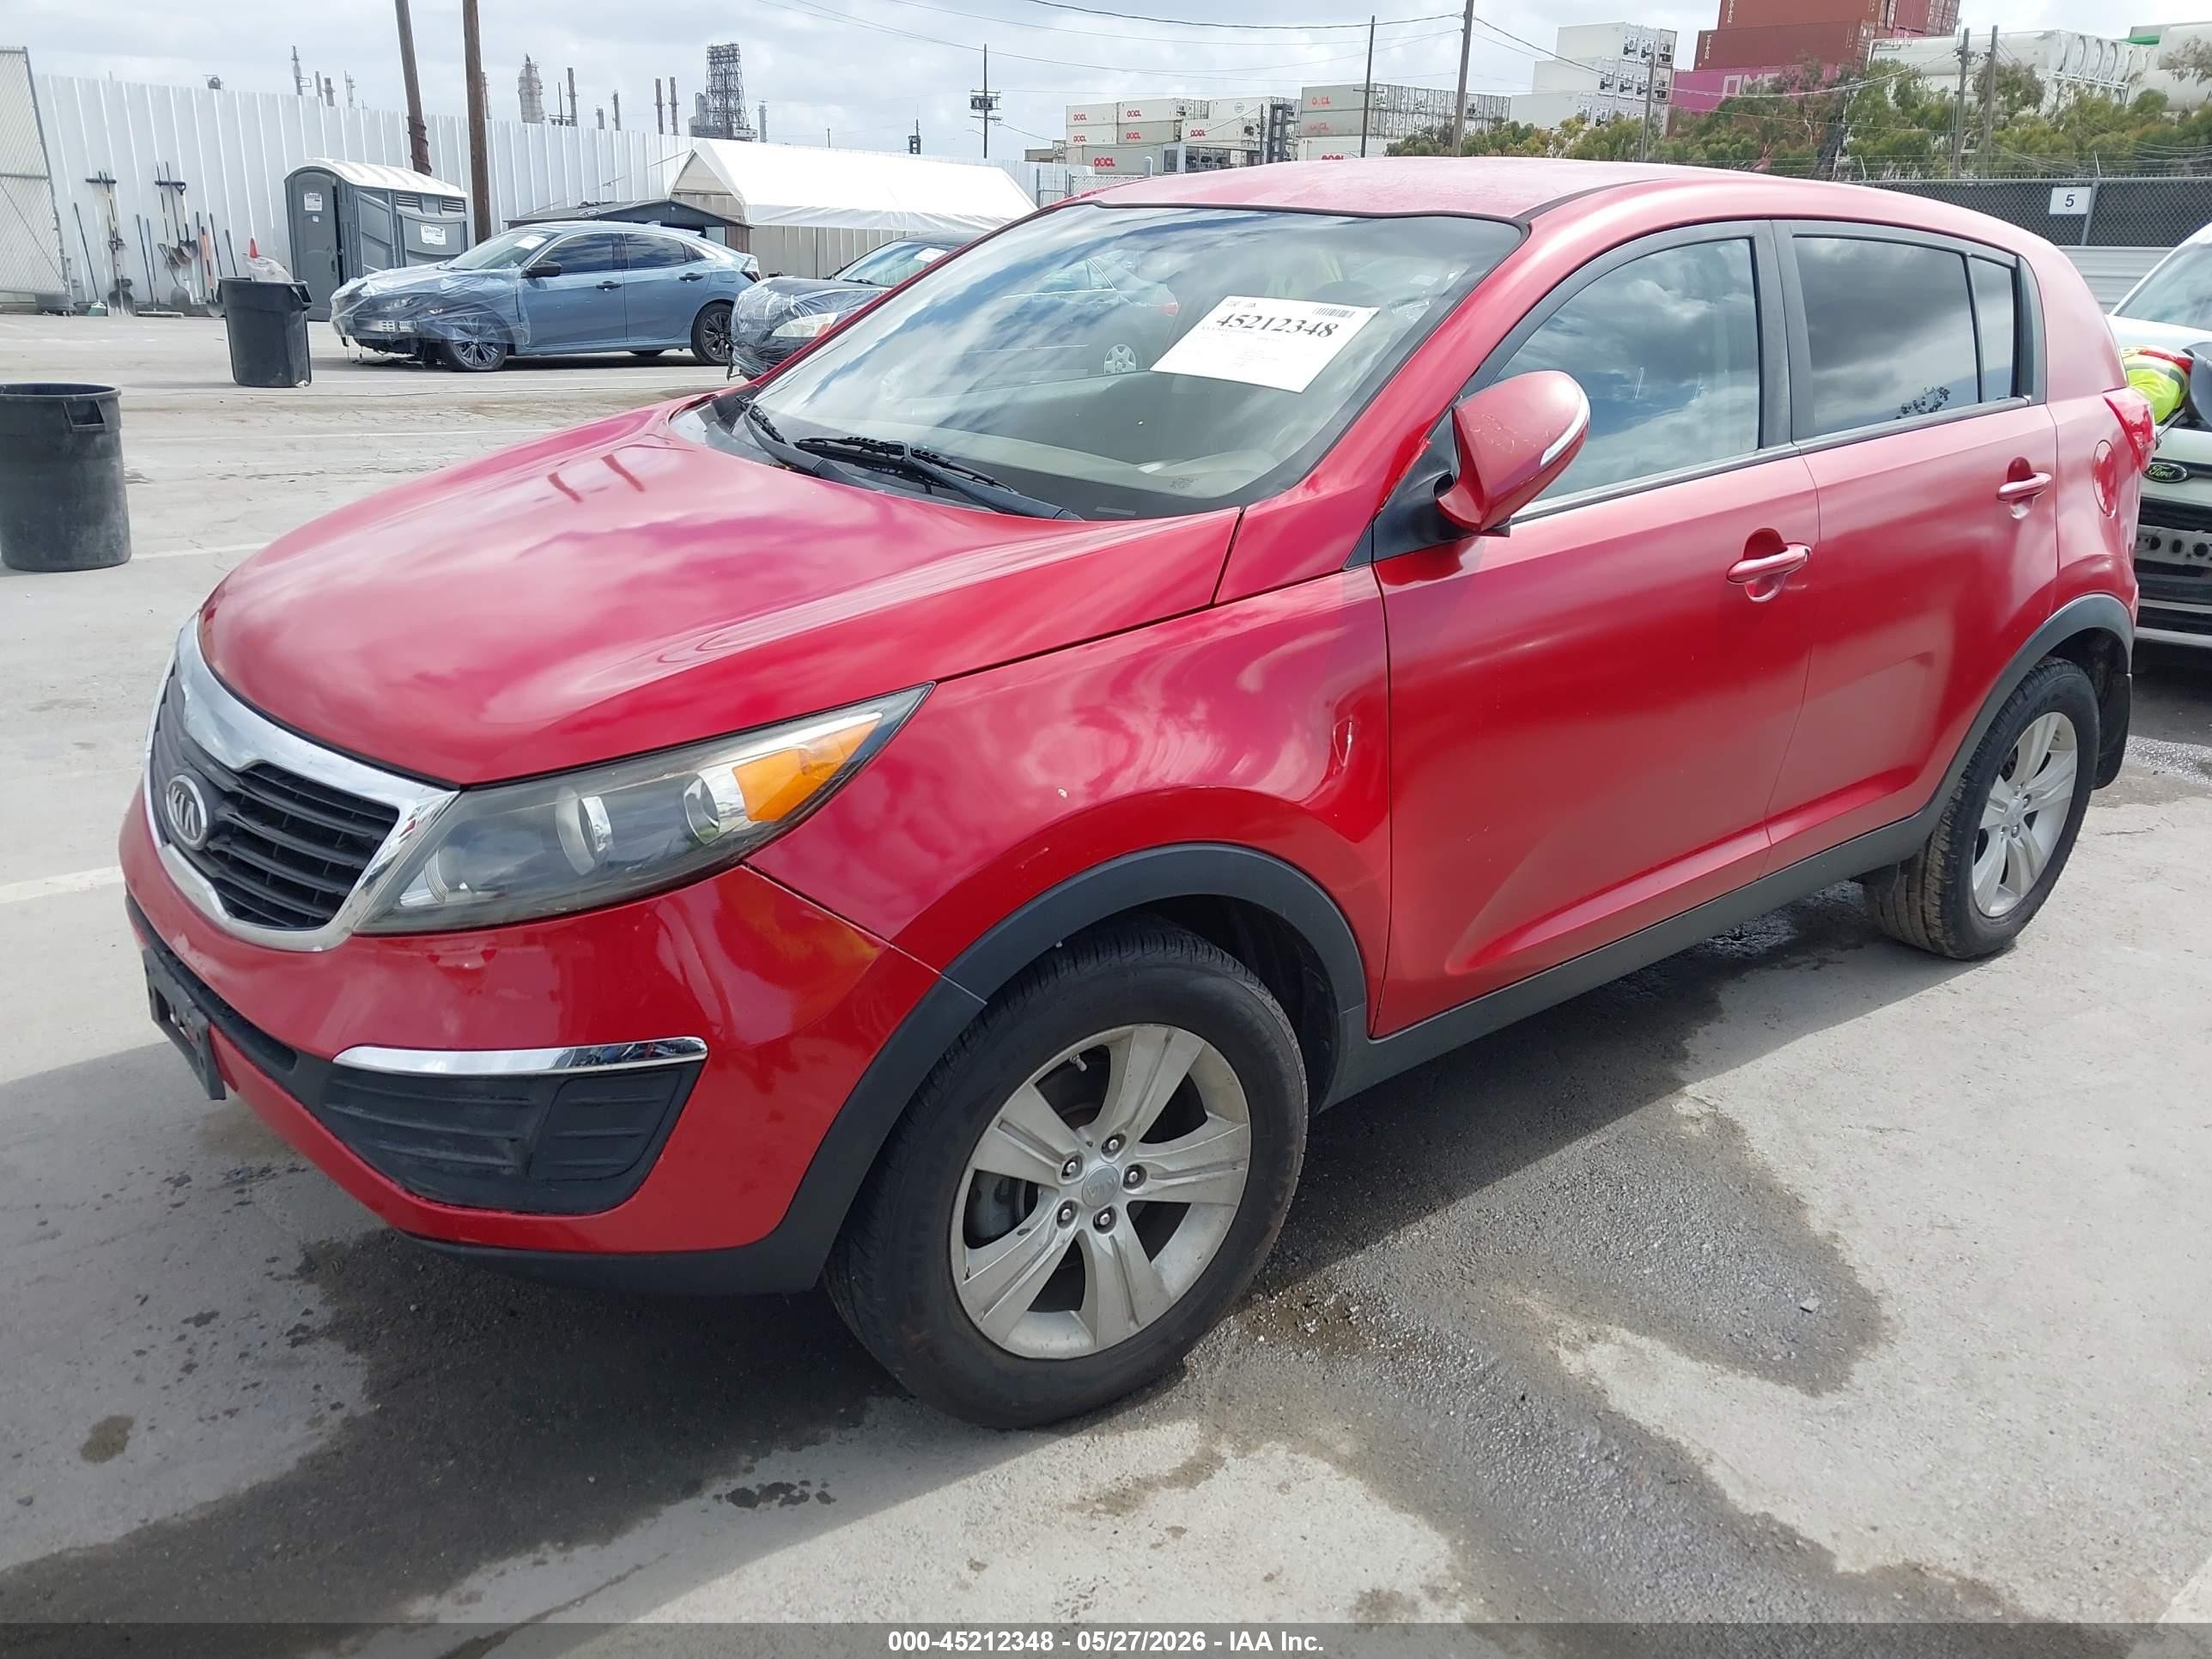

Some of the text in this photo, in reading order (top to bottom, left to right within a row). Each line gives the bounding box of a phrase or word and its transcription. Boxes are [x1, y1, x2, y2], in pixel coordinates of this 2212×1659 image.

[1127, 131, 1141, 140] OOCL
[1189, 129, 1206, 137] OOCL
[1093, 157, 1115, 167] OOCL
[2065, 194, 2075, 207] 5
[1216, 313, 1339, 337] 45212348
[2148, 465, 2176, 478] Ford
[171, 784, 198, 837] KIA
